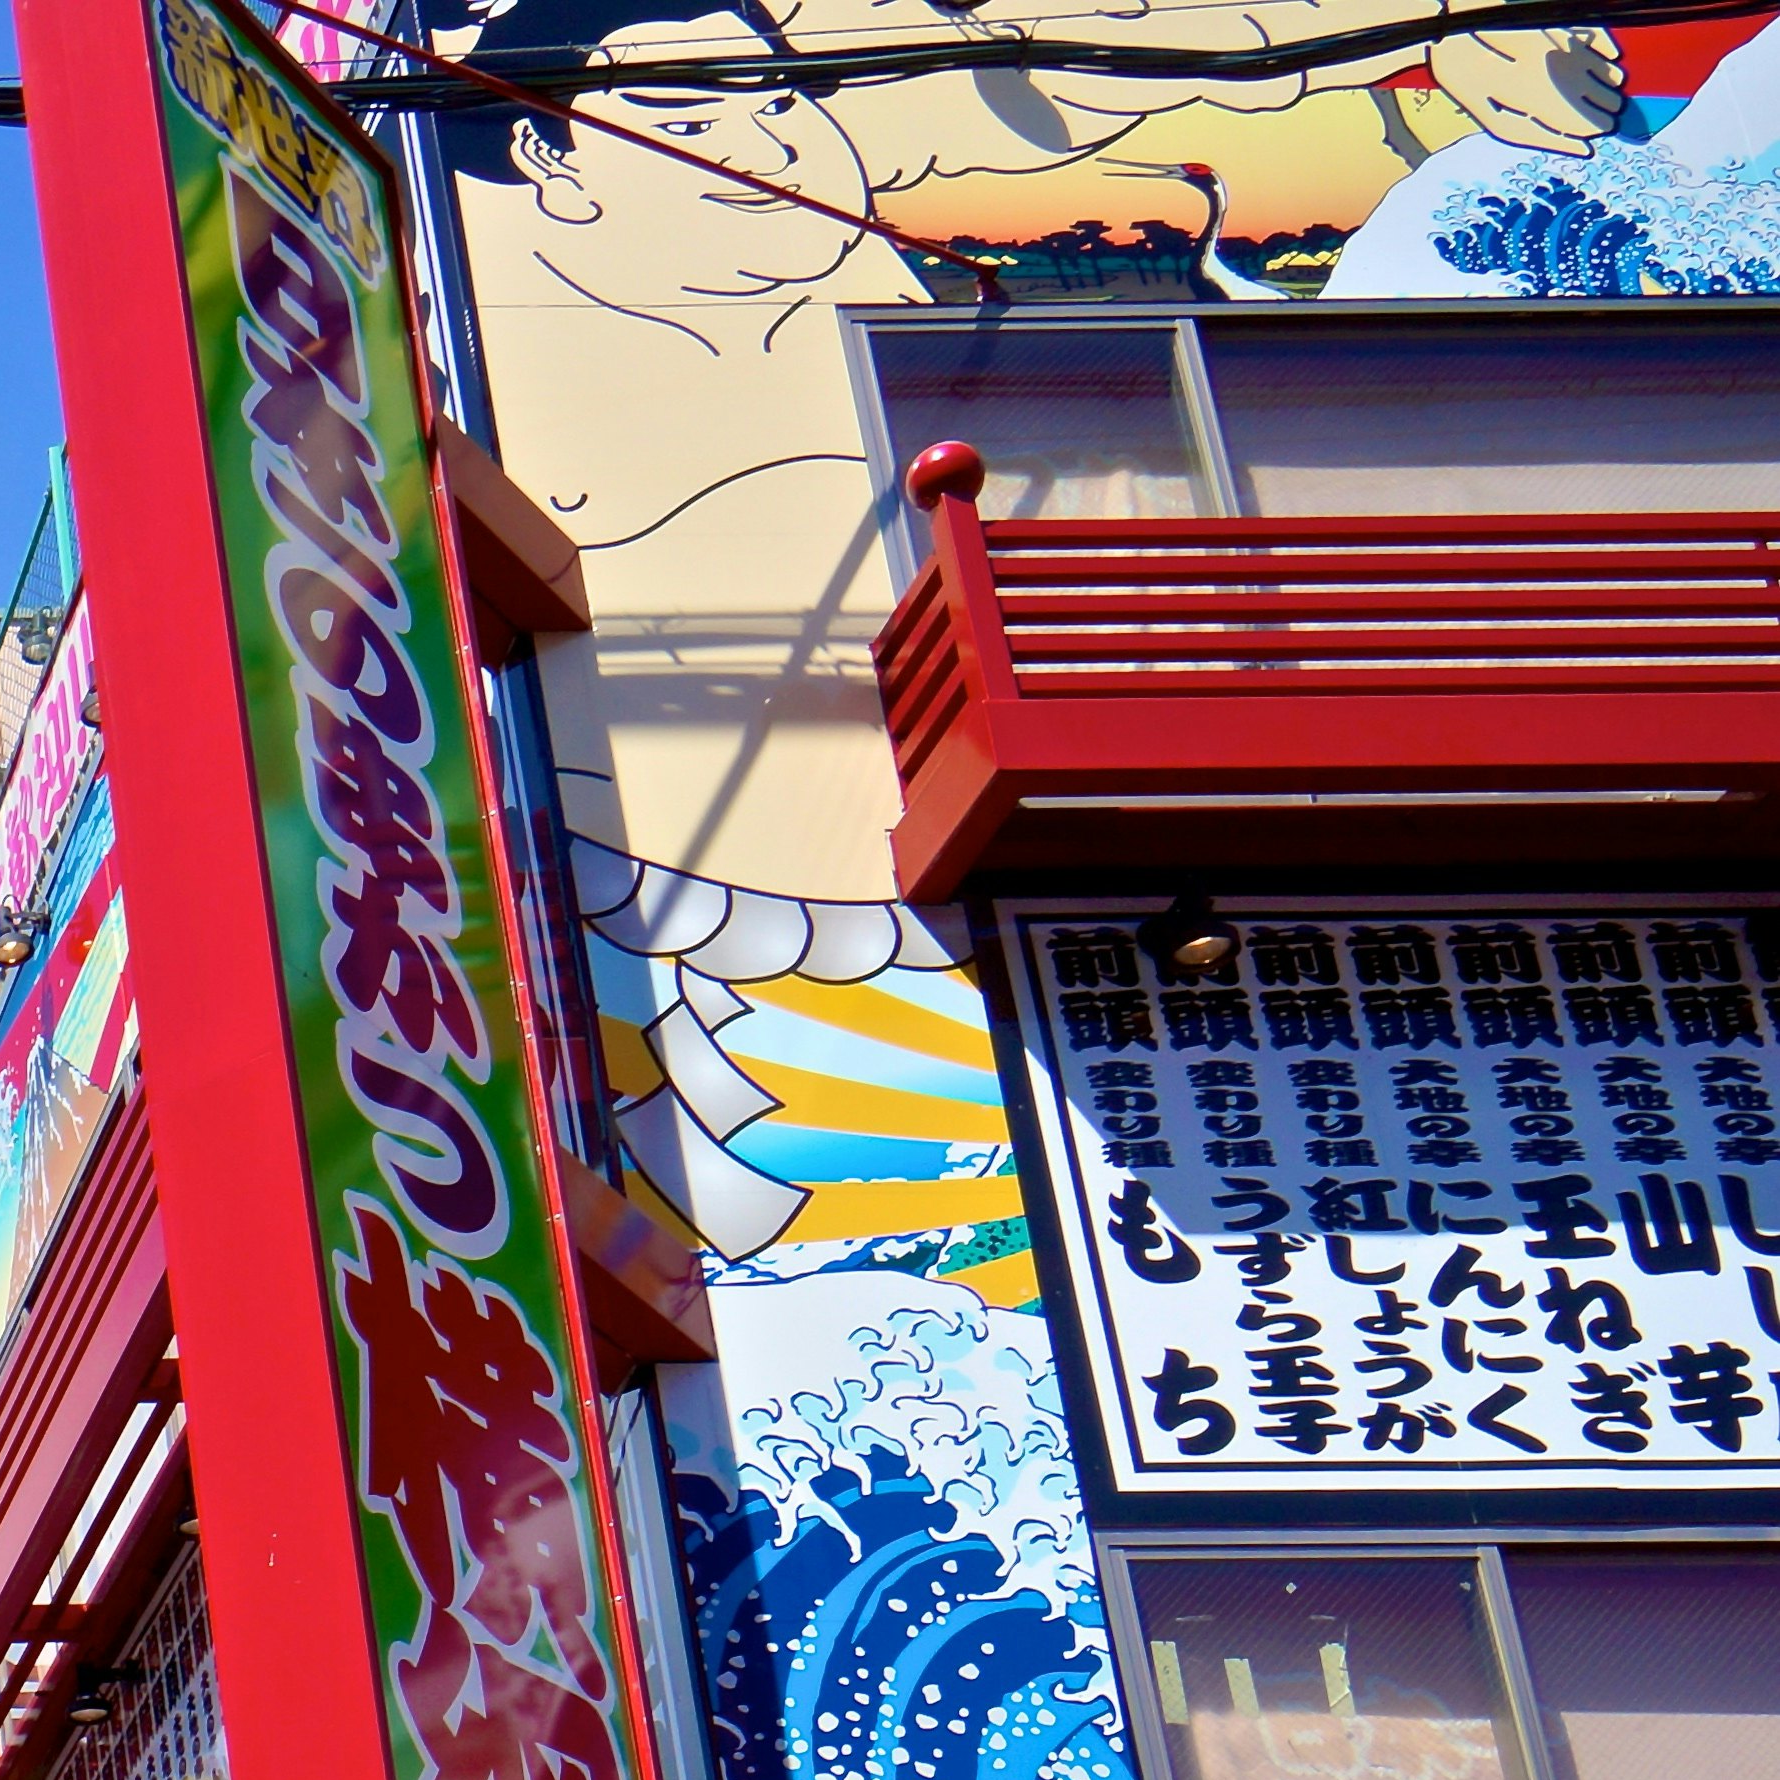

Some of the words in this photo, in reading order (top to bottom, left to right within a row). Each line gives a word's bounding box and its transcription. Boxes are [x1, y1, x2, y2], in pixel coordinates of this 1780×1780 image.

[162, 0, 382, 288] 新世界
[229, 168, 499, 1238] 日本一の串かつ
[1047, 923, 1158, 1053] 前頭
[1246, 923, 1359, 1053] 前頭
[1345, 923, 1463, 1053] 前頭
[1446, 923, 1564, 1053] 前頭
[1547, 923, 1666, 1053] 前頭
[1647, 923, 1765, 1053] 前頭
[1085, 1057, 1174, 1169] 変わり種
[1185, 1057, 1276, 1169] 変わり種
[1286, 1057, 1379, 1169] 変わり種
[1388, 1057, 1482, 1169] 大地の幸
[1489, 1057, 1587, 1169] 大地の幸
[1592, 1057, 1687, 1169] 大地の幸
[1693, 1057, 1780, 1169] 大地の幸
[1107, 1178, 1237, 1457] もち
[1211, 1175, 1353, 1456] うずら玉子
[1299, 1175, 1453, 1454] 紅しょうが
[1407, 1178, 1548, 1453] にんにく
[1510, 1173, 1657, 1453] 玉ねぎ
[1615, 1171, 1765, 1453] 山芋
